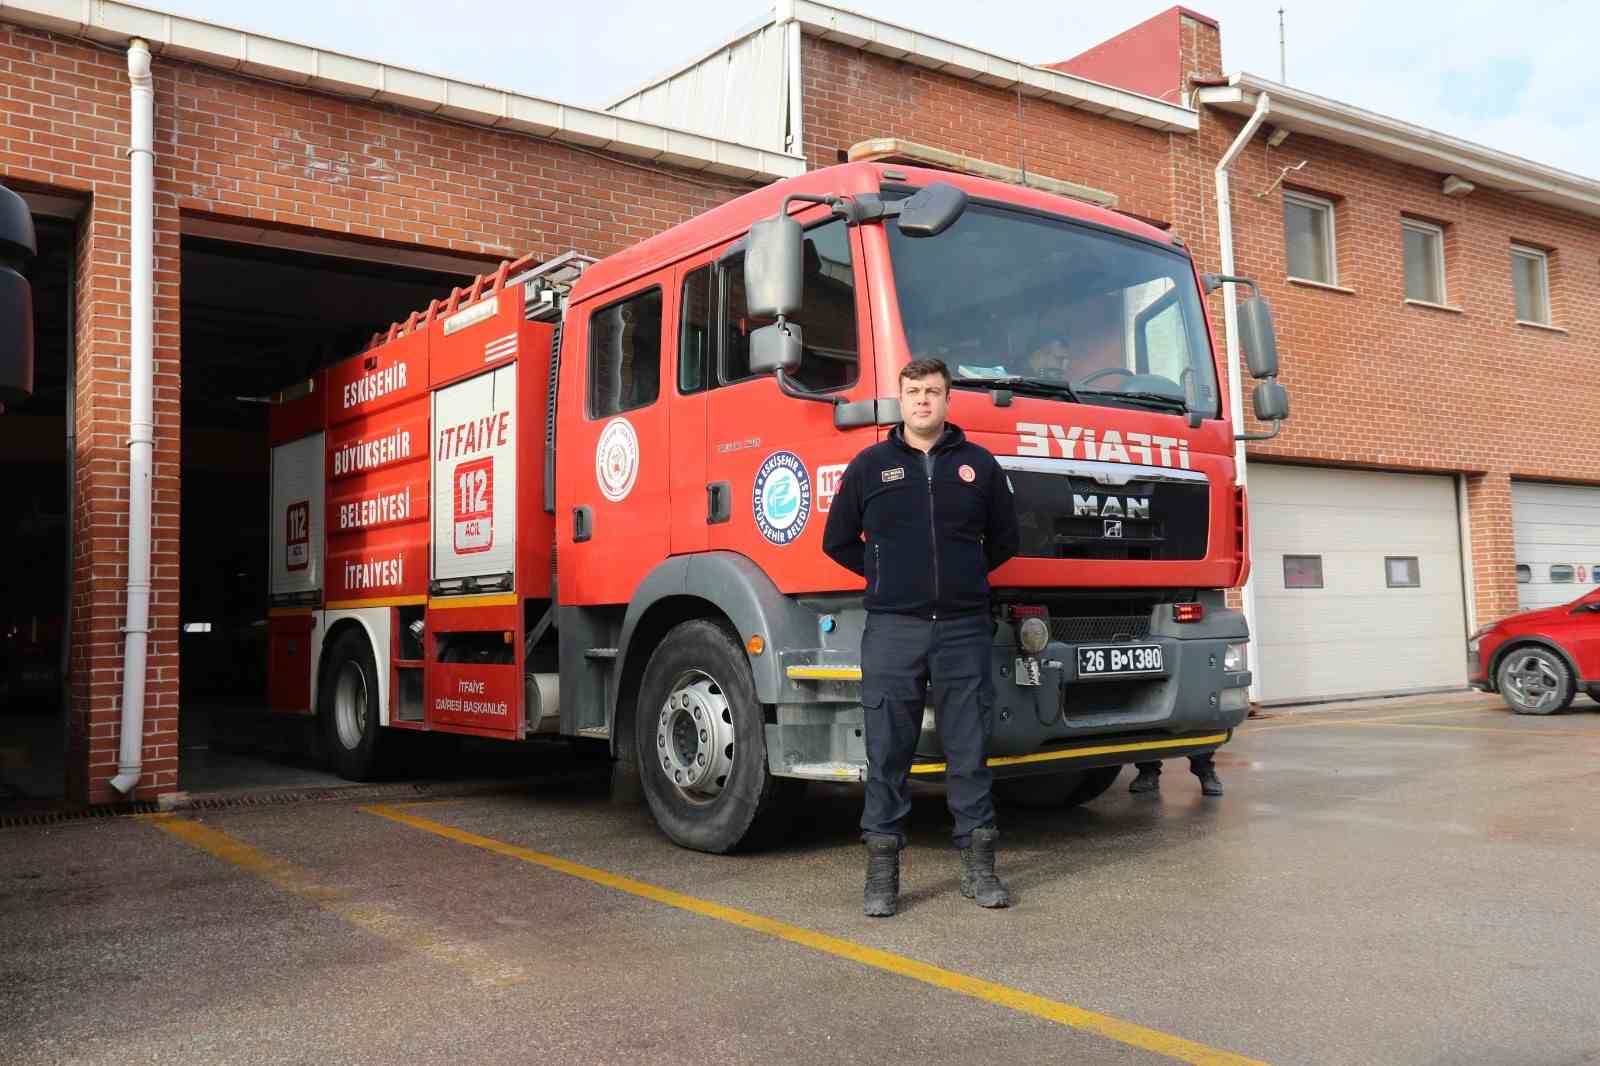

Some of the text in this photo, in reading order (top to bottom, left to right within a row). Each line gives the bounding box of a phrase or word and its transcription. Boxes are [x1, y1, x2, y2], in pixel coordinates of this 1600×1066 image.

[334, 428, 410, 475] BÜYÜKŞEHİR
[438, 411, 509, 461] İTFAİYE
[340, 487, 410, 528] BELEDİYESİ
[459, 468, 488, 514] 112
[1072, 494, 1150, 520] MAN
[290, 506, 306, 541] 112
[345, 552, 403, 590] İTFAİYESİ
[1086, 650, 1104, 671] 26
[458, 679, 485, 694] İTFAİYE
